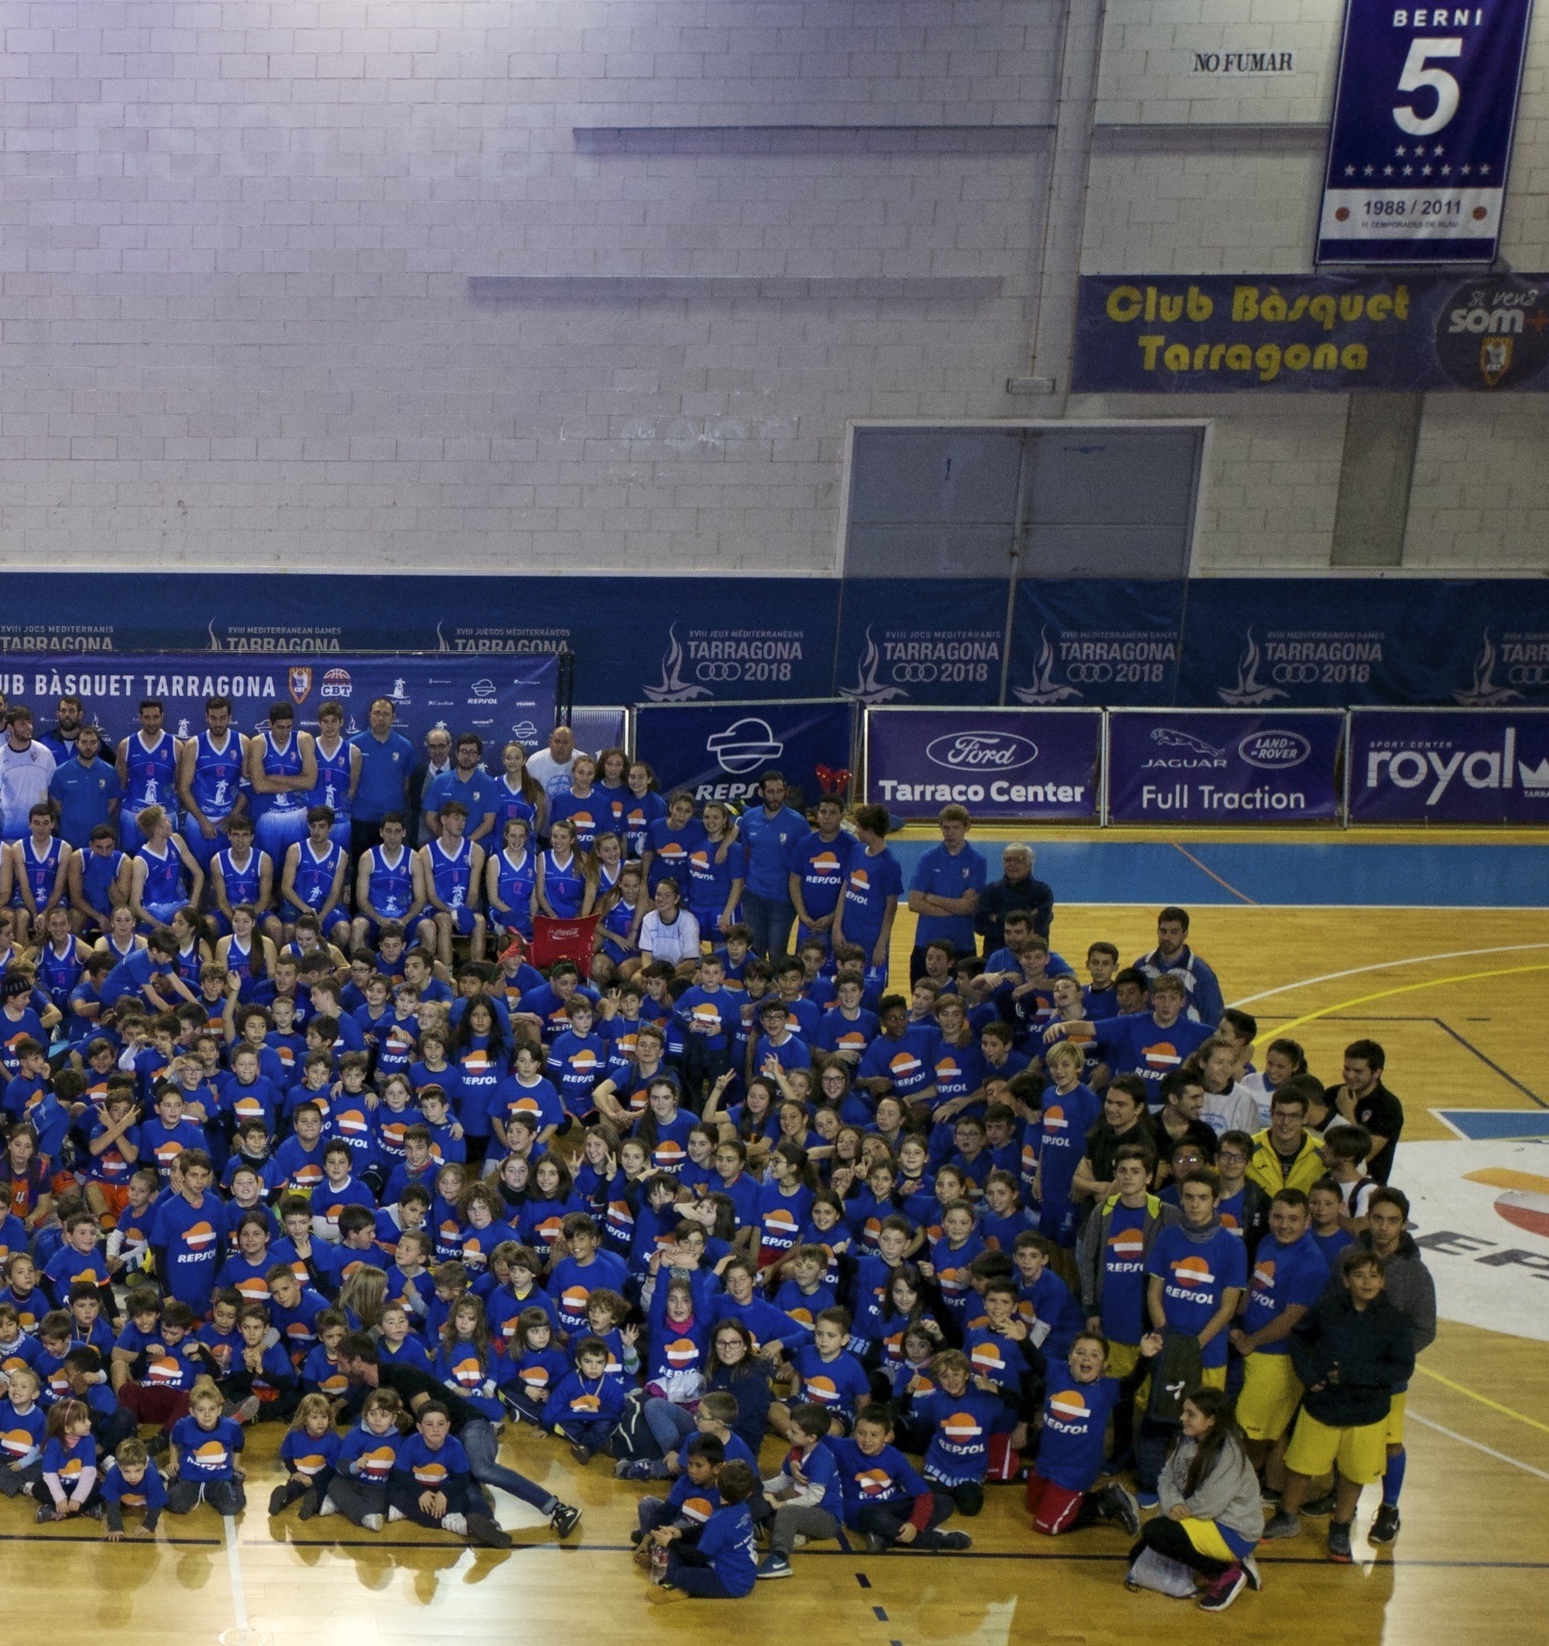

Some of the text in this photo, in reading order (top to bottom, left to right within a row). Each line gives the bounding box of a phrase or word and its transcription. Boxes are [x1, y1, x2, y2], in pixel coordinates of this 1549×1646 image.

[1392, 9, 1482, 27] BERNI
[1193, 52, 1293, 72] NO FUMAR
[1392, 37, 1463, 136] 5
[1363, 200, 1406, 216] 1988
[1421, 200, 1462, 215] 2011
[1106, 285, 1409, 330] Club Bàsquet
[1138, 335, 1369, 381] Tarragona
[23, 625, 45, 633] JOCS
[47, 625, 114, 634] MEDITERRANIS
[248, 627, 312, 635] MEDITERRANEAN
[687, 641, 803, 660] TARRAGONA
[884, 642, 1000, 660] TARRAGONA
[1059, 642, 1176, 661] TARRAGONA
[1265, 643, 1383, 662] TARRAGONA
[744, 663, 791, 681] 2018
[940, 664, 988, 681] 2018
[1115, 663, 1163, 682] 2018
[1321, 664, 1370, 682] 2018
[35, 669, 135, 696] BÀSQUET
[144, 675, 276, 697] TARRAGONA
[947, 736, 1018, 766] Ford
[1141, 759, 1227, 769] JAGUAR
[1367, 726, 1516, 805] royal
[878, 780, 1085, 802] Tarraco Center
[1142, 785, 1306, 810] Full Traction
[806, 875, 841, 885] REPSOL
[563, 1074, 595, 1083] REPSO
[15, 1191, 25, 1204] 4
[436, 1245, 462, 1257] REPSO
[1166, 1285, 1214, 1305] REPSOL
[938, 1438, 985, 1455] REPSOL
